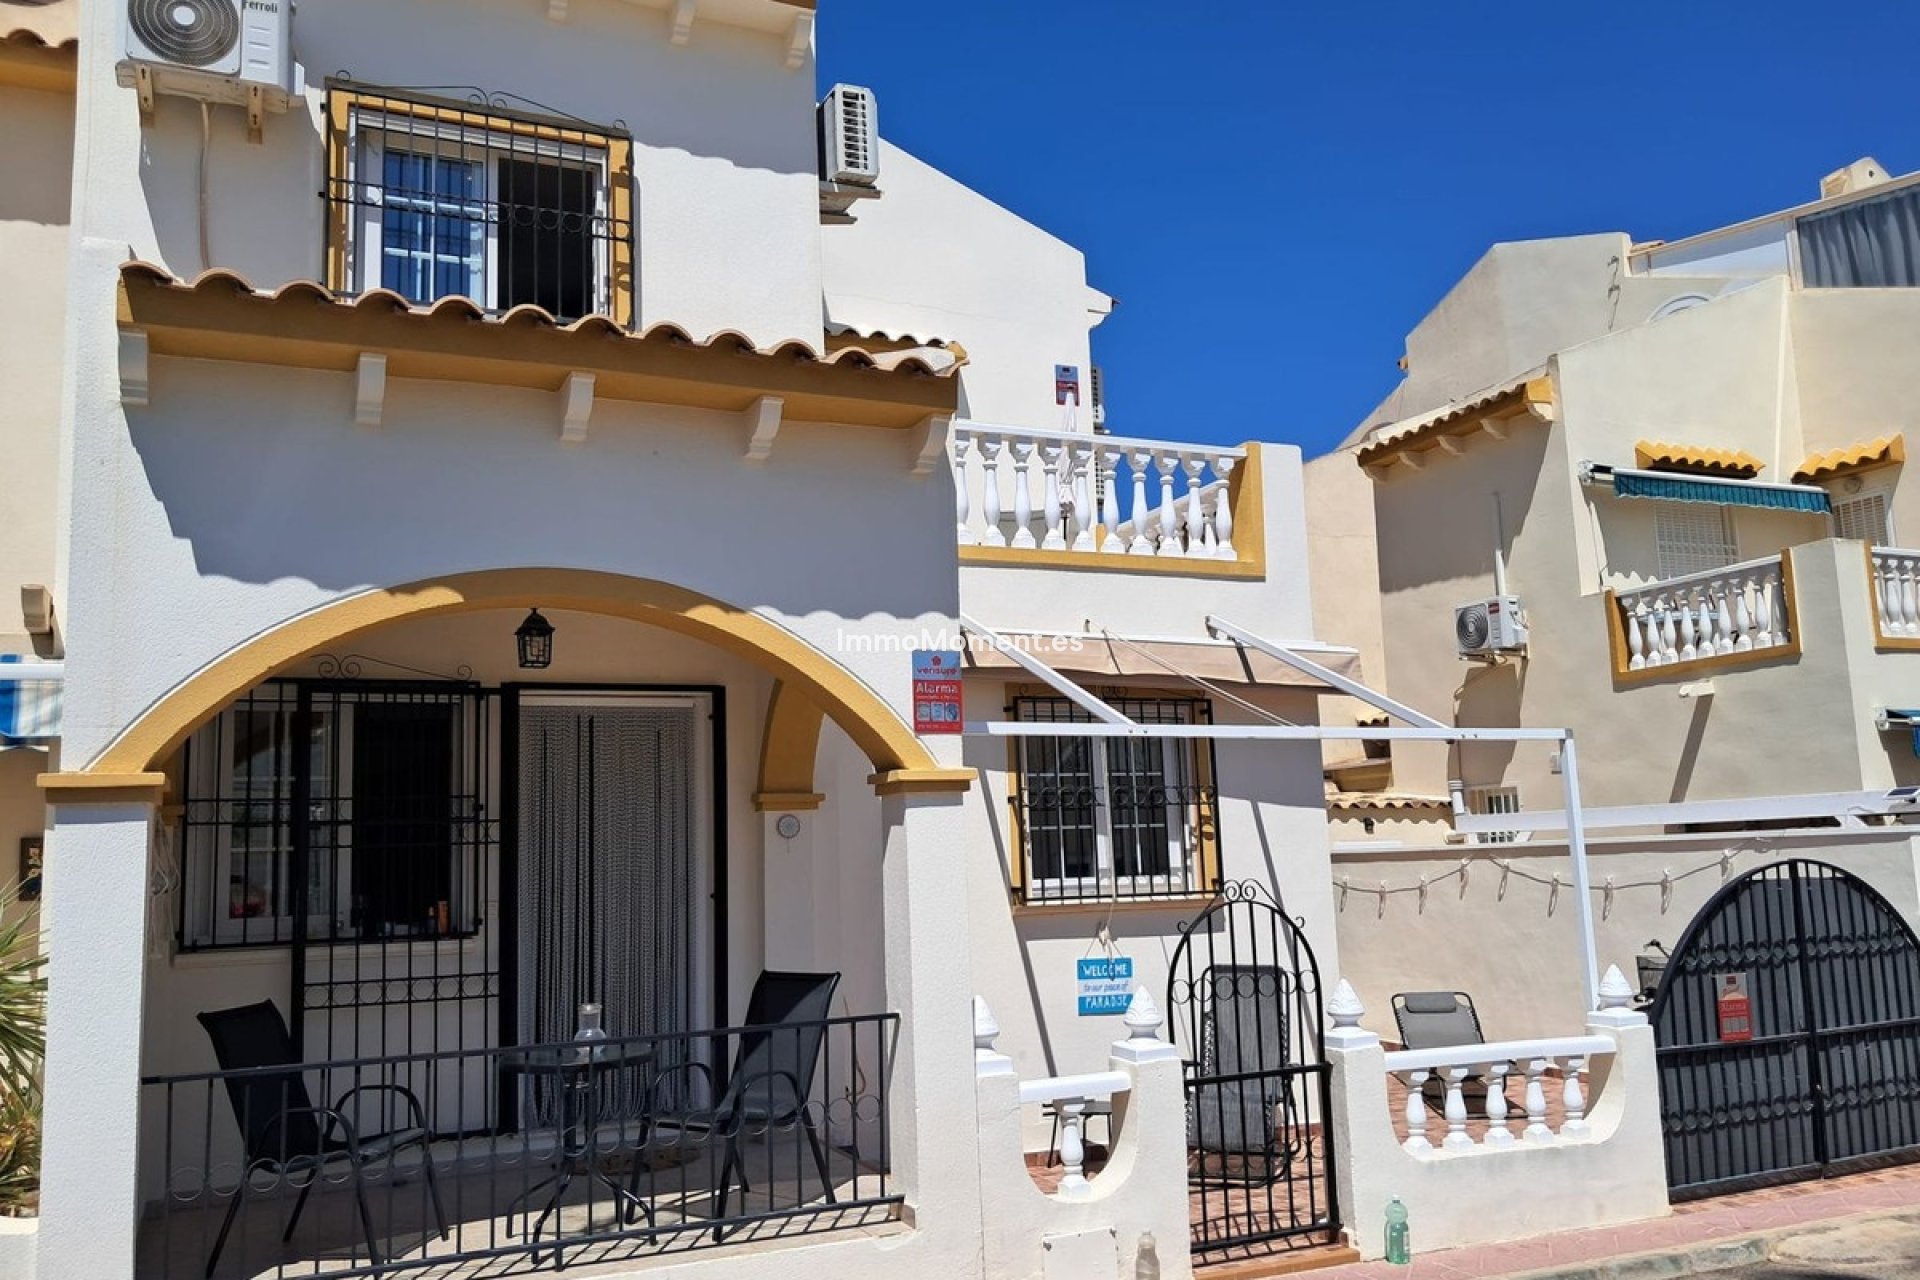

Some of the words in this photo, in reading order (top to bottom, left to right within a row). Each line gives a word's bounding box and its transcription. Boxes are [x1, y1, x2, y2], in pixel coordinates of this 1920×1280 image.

[916, 681, 958, 693] Alarma
[1081, 963, 1128, 977] WELCOME
[1086, 995, 1128, 1009] PARADISE
